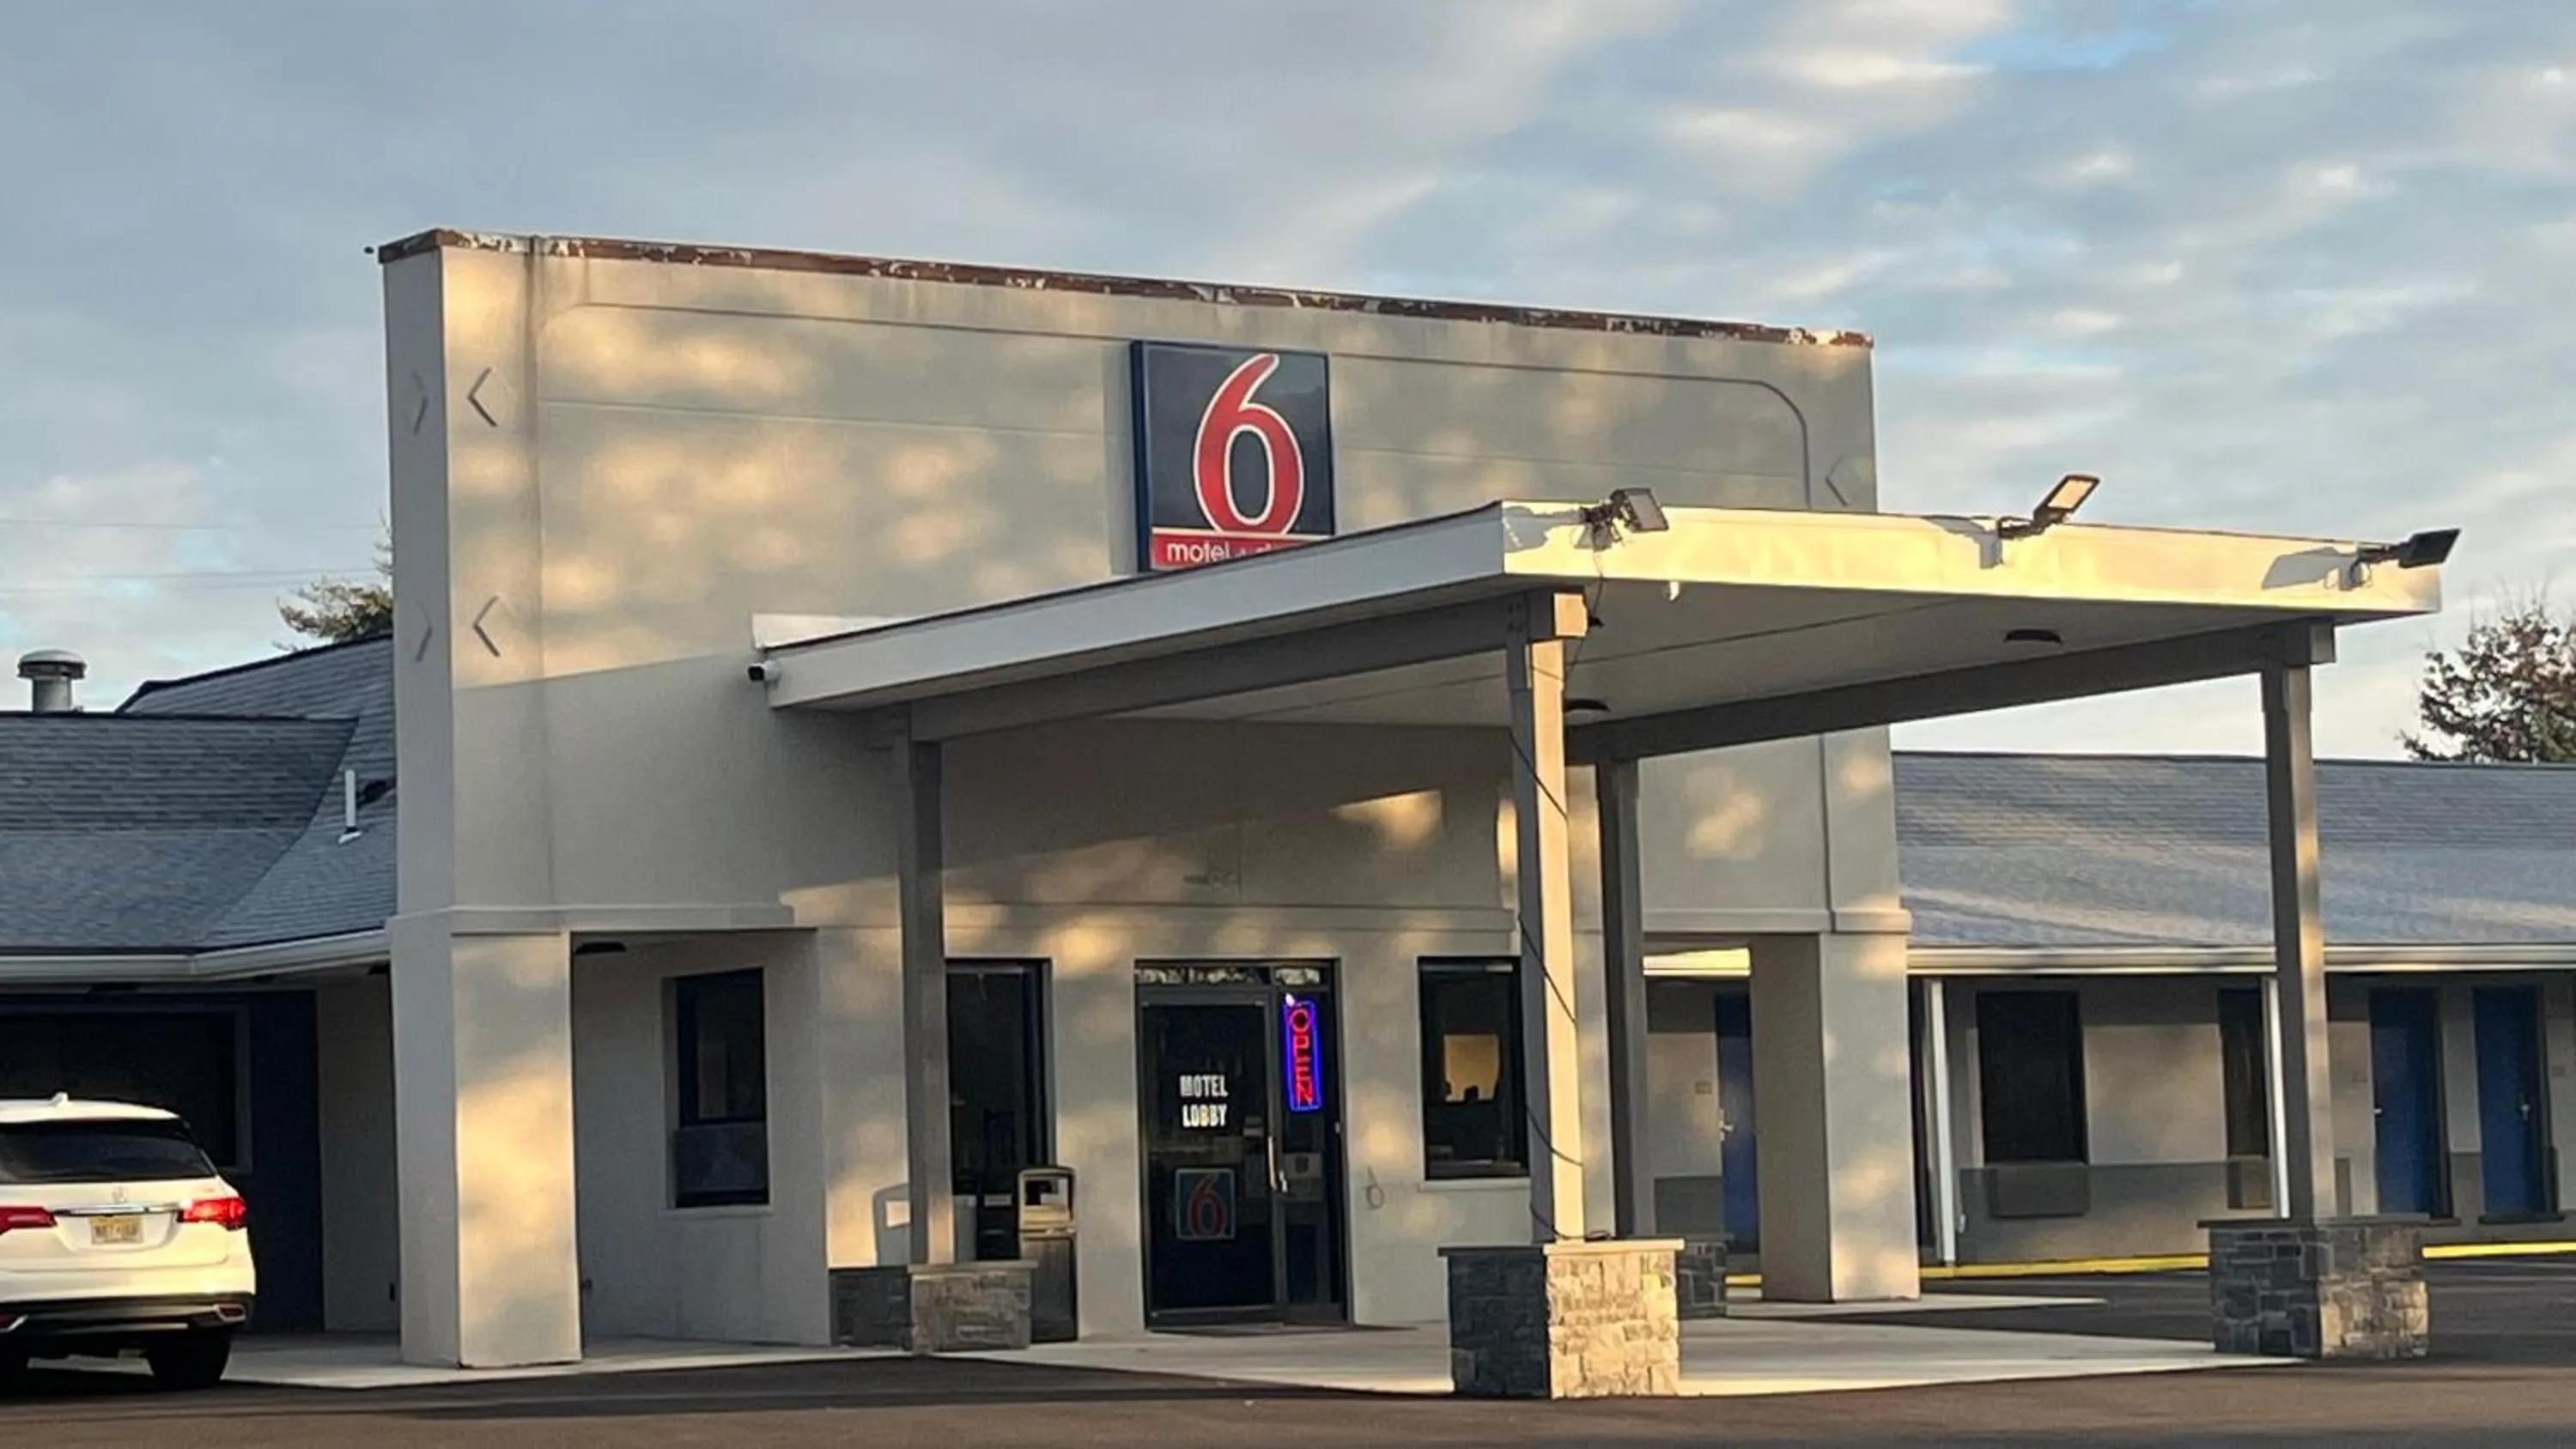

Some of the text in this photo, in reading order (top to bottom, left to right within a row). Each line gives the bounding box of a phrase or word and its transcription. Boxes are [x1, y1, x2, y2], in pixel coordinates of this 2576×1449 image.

[1194, 353, 1304, 535] 6
[1166, 540, 1230, 563] motel
[1291, 1009, 1313, 1106] OPEN
[1180, 1074, 1229, 1097] MOTEL
[1182, 1103, 1227, 1127] LOBBY
[1188, 1173, 1228, 1236] 6
